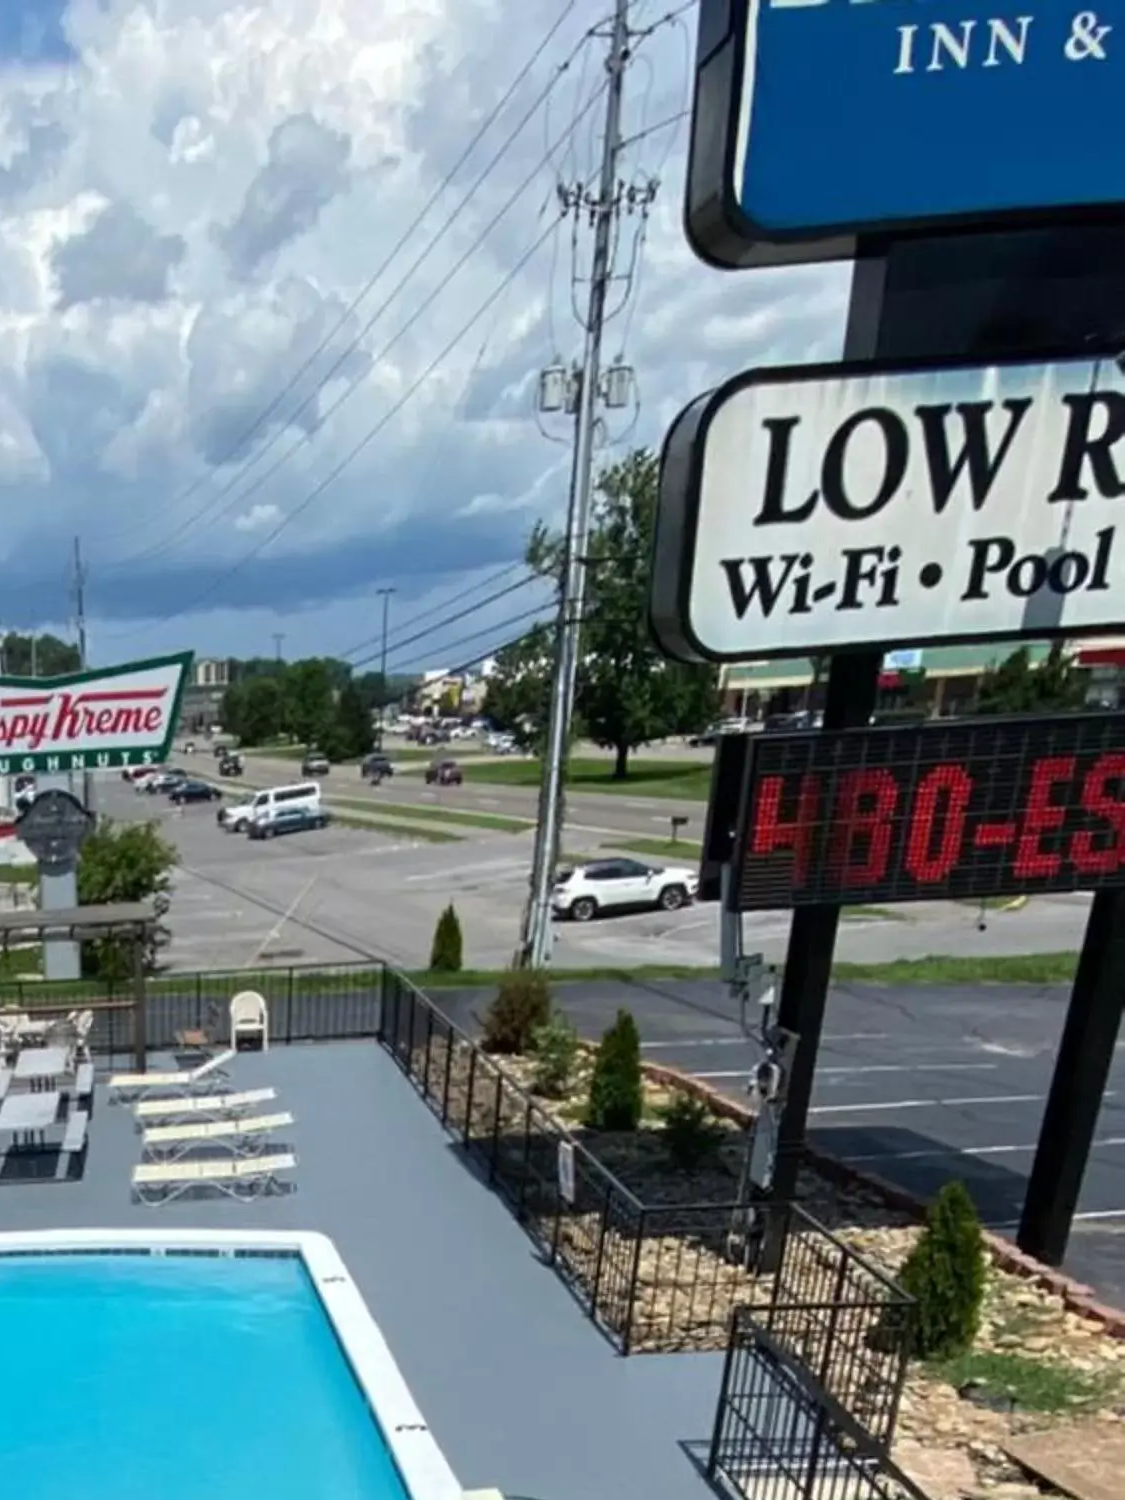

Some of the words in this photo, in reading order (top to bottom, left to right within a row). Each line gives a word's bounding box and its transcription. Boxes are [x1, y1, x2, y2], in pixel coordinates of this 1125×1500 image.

[893, 17, 1034, 74] INN
[1064, 11, 1113, 61] &
[753, 397, 1033, 527] LOW
[720, 545, 902, 620] Wi-Fi
[961, 526, 1116, 600] Pool
[52, 687, 170, 741] Kreme
